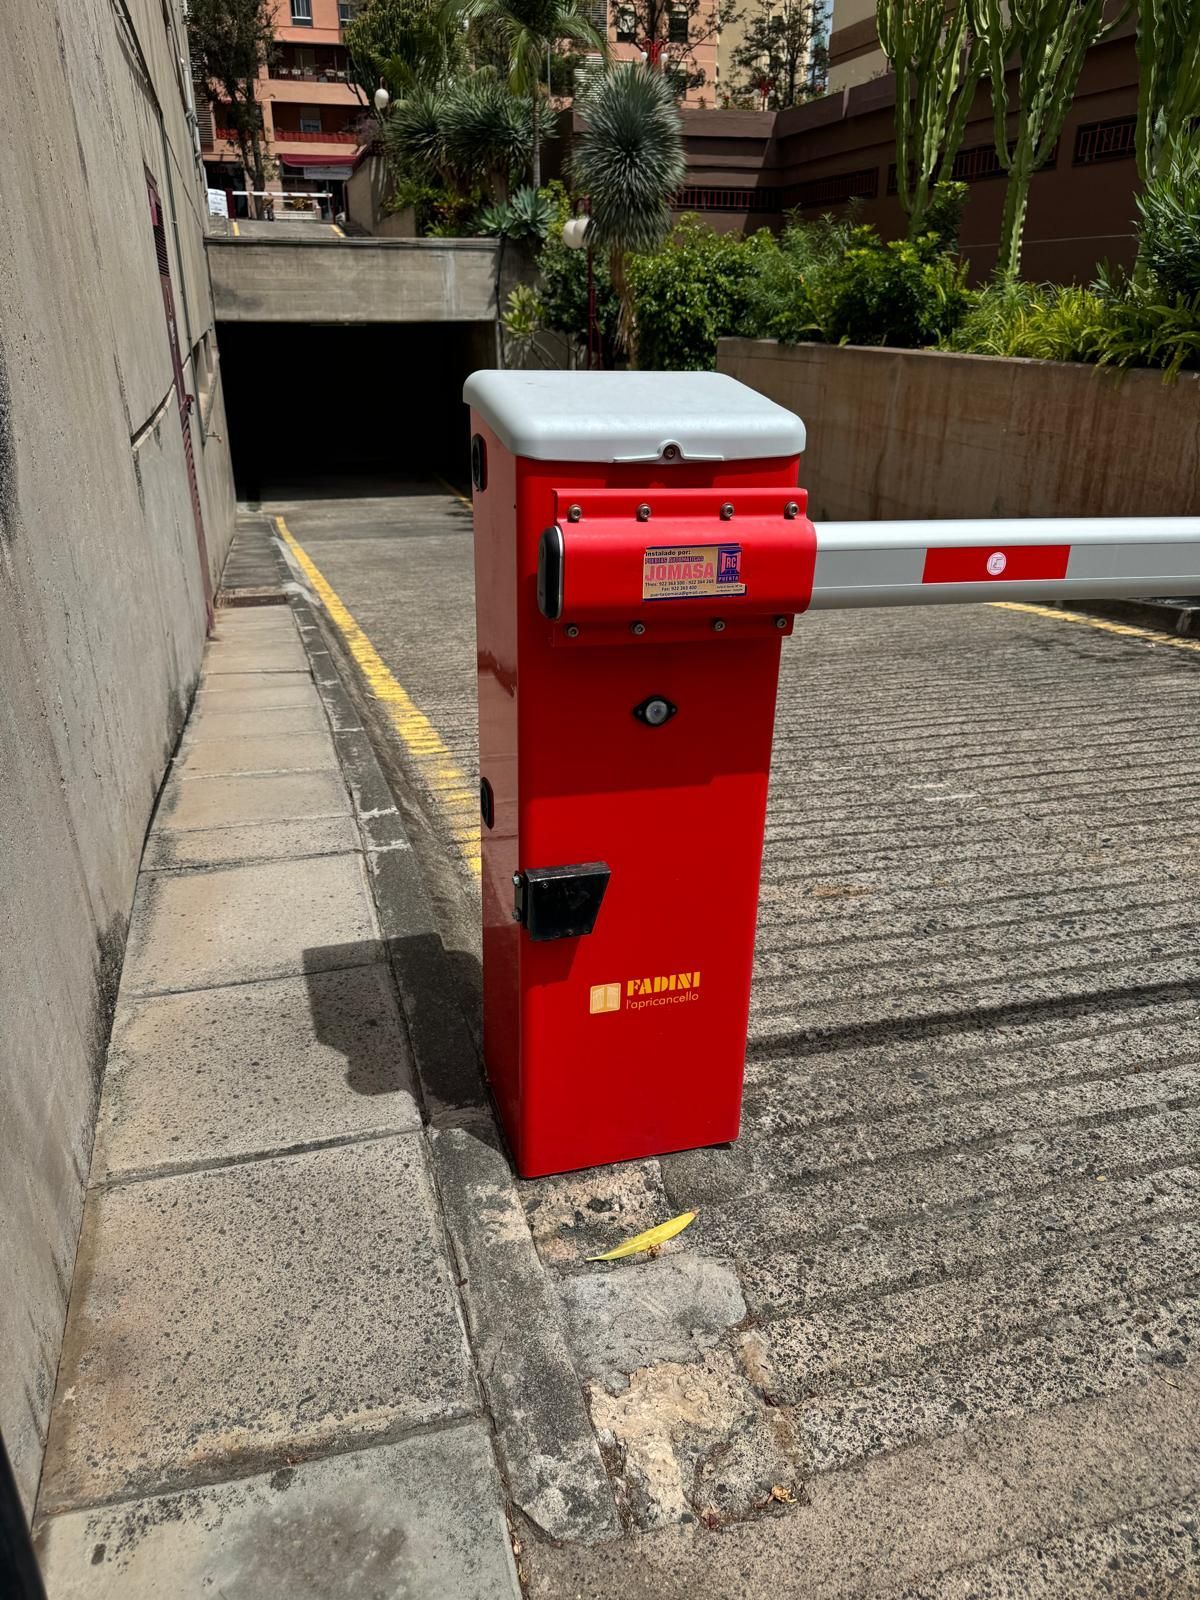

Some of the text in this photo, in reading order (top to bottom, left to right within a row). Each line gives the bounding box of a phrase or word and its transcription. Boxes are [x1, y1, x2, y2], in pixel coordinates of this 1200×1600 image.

[644, 562, 714, 581] JOMASA
[726, 557, 736, 568] RC
[627, 972, 700, 996] FADINI
[626, 991, 699, 1010] l'apricancello
